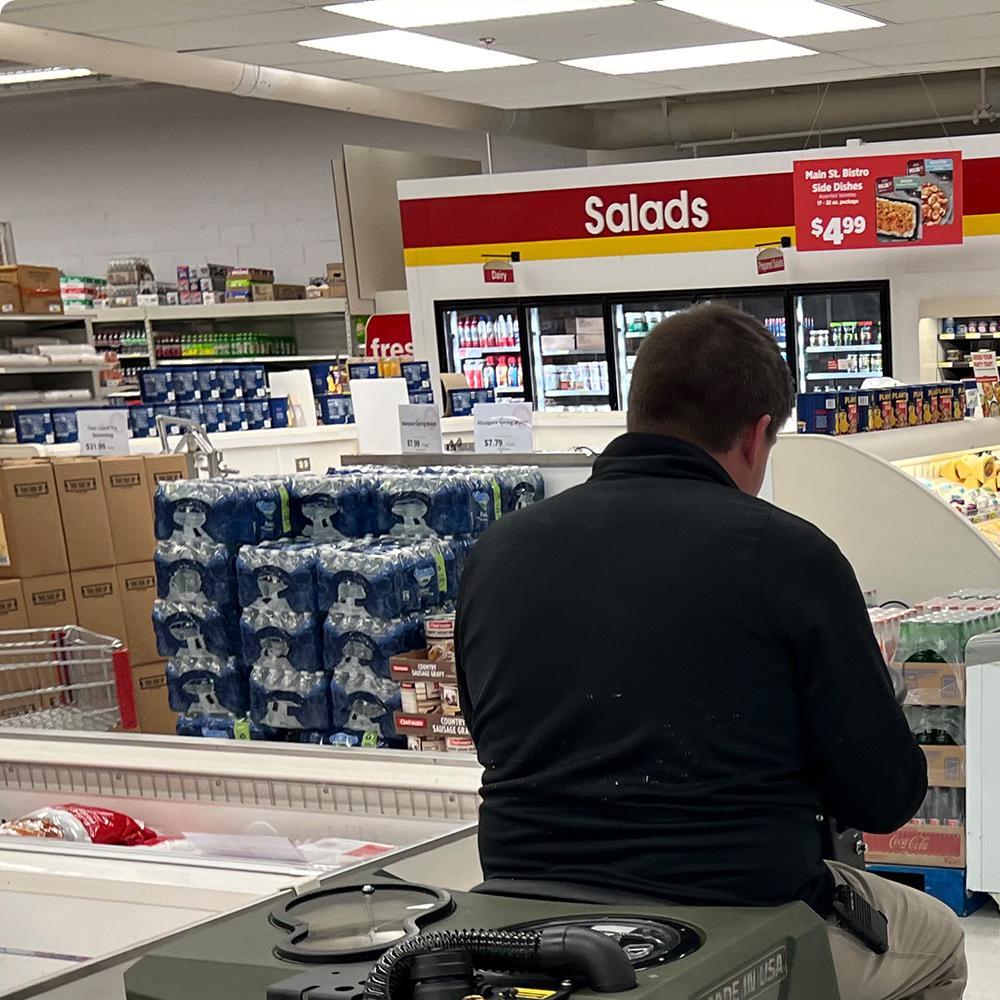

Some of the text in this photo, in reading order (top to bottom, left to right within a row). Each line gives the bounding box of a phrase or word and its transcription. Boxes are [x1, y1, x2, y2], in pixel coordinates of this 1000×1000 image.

[805, 168, 869, 180] Main St. Bistro
[812, 181, 863, 193] Side Dishes
[584, 190, 709, 235] Salads
[491, 270, 507, 282] Dairy
[411, 669, 431, 677] SAUSAGE
[432, 725, 457, 734] SAUSAGE
[743, 969, 756, 997] IN
[760, 953, 783, 987] USA
